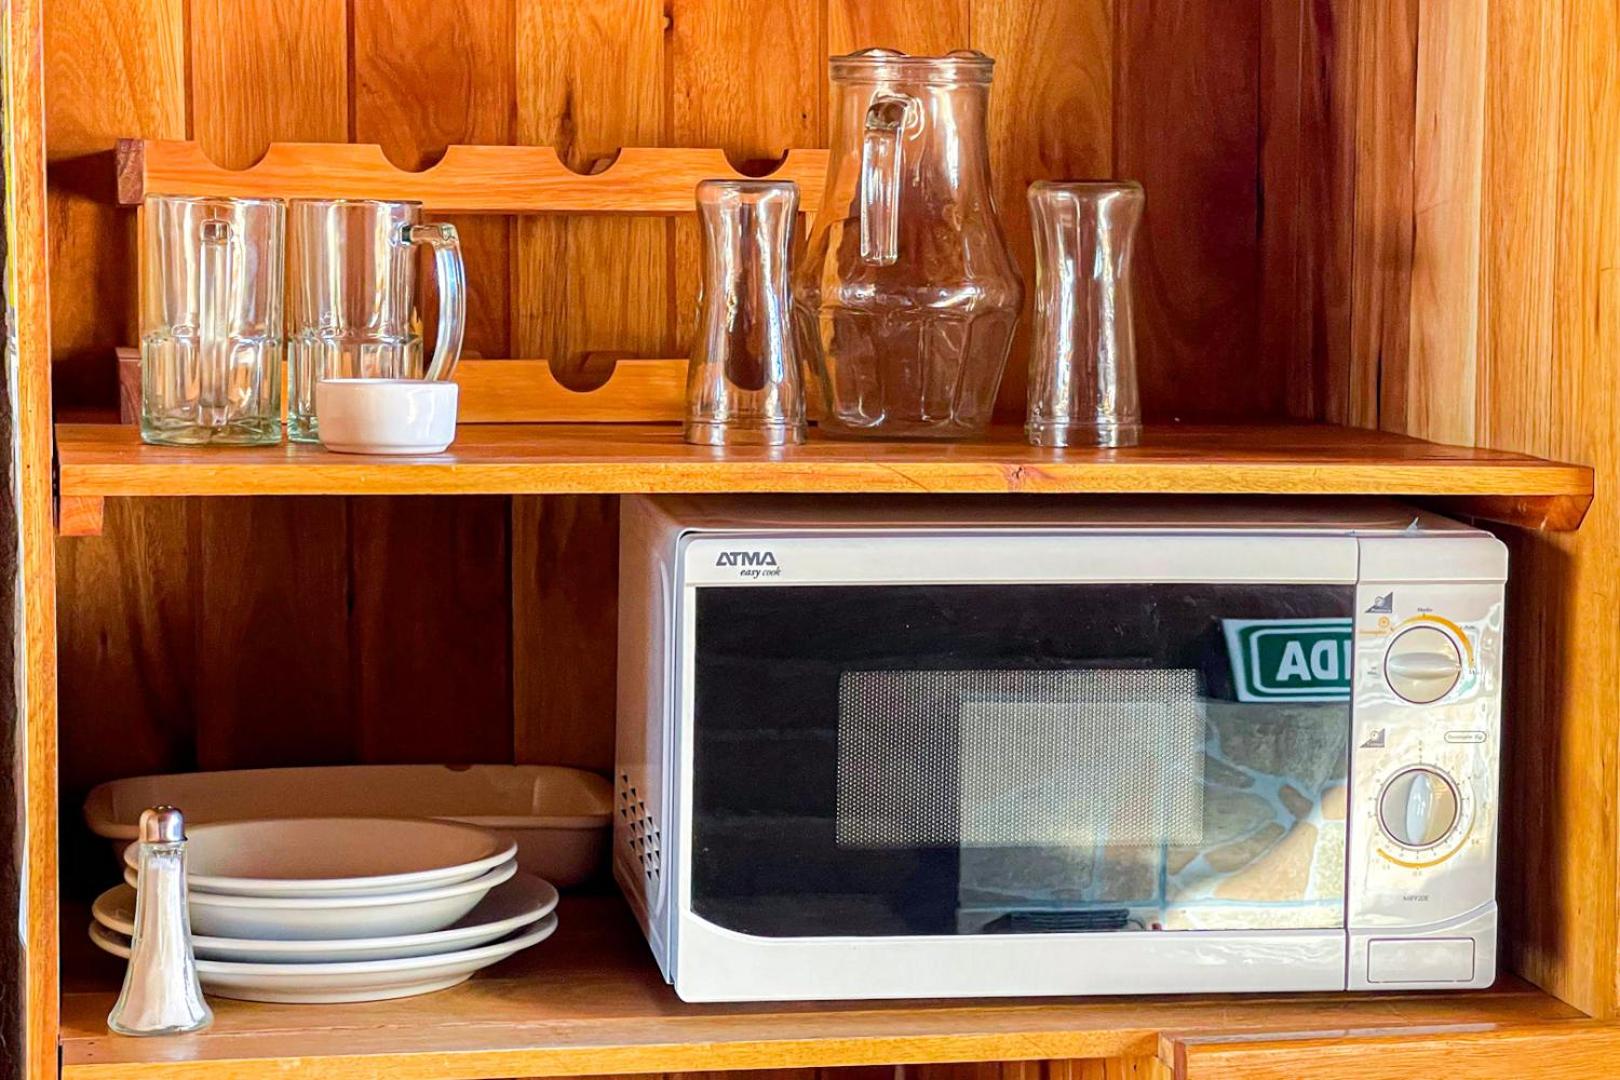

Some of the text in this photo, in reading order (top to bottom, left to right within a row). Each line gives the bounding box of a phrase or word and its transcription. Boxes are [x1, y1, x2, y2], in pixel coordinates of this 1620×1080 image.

[715, 551, 777, 566] ATMA
[740, 566, 782, 579] easy cook
